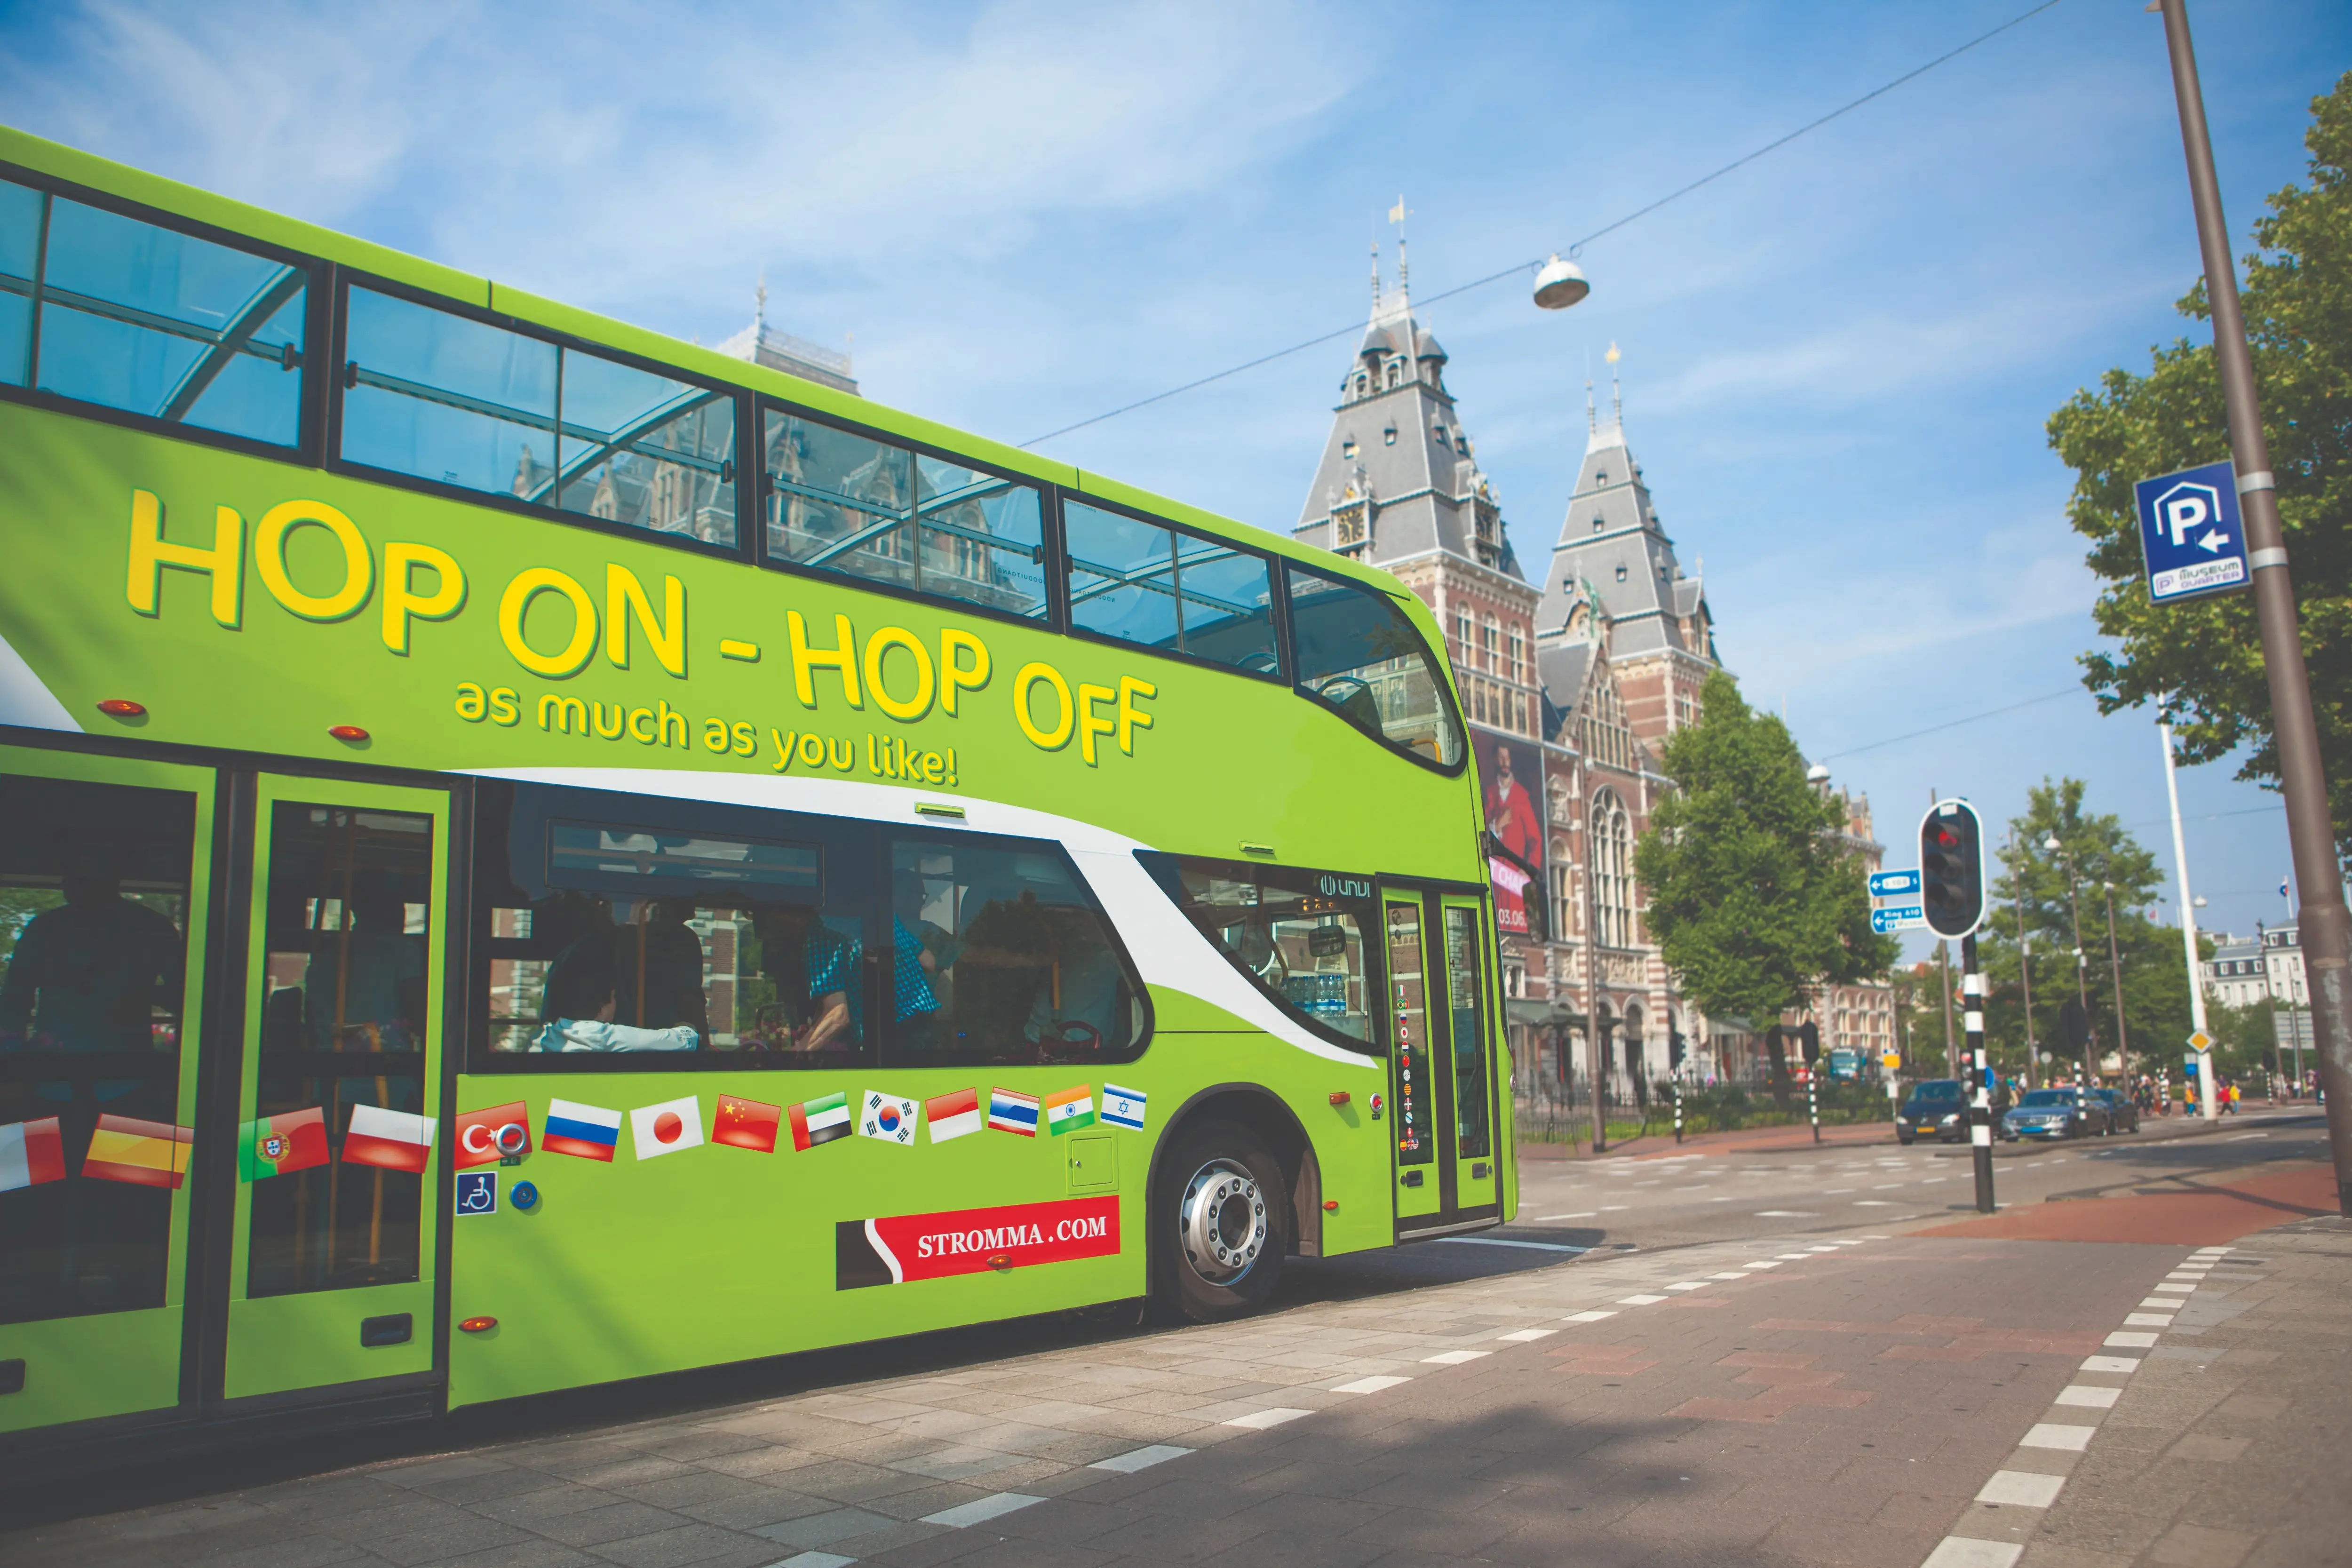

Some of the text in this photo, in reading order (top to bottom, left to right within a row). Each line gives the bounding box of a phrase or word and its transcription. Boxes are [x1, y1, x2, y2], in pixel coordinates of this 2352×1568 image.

[126, 488, 466, 652] HOP
[498, 562, 686, 677] ON
[786, 609, 992, 719] HOP
[1012, 661, 1157, 765] OFF
[2181, 571, 2240, 589] QUARTER
[454, 681, 957, 785] as much as you like!
